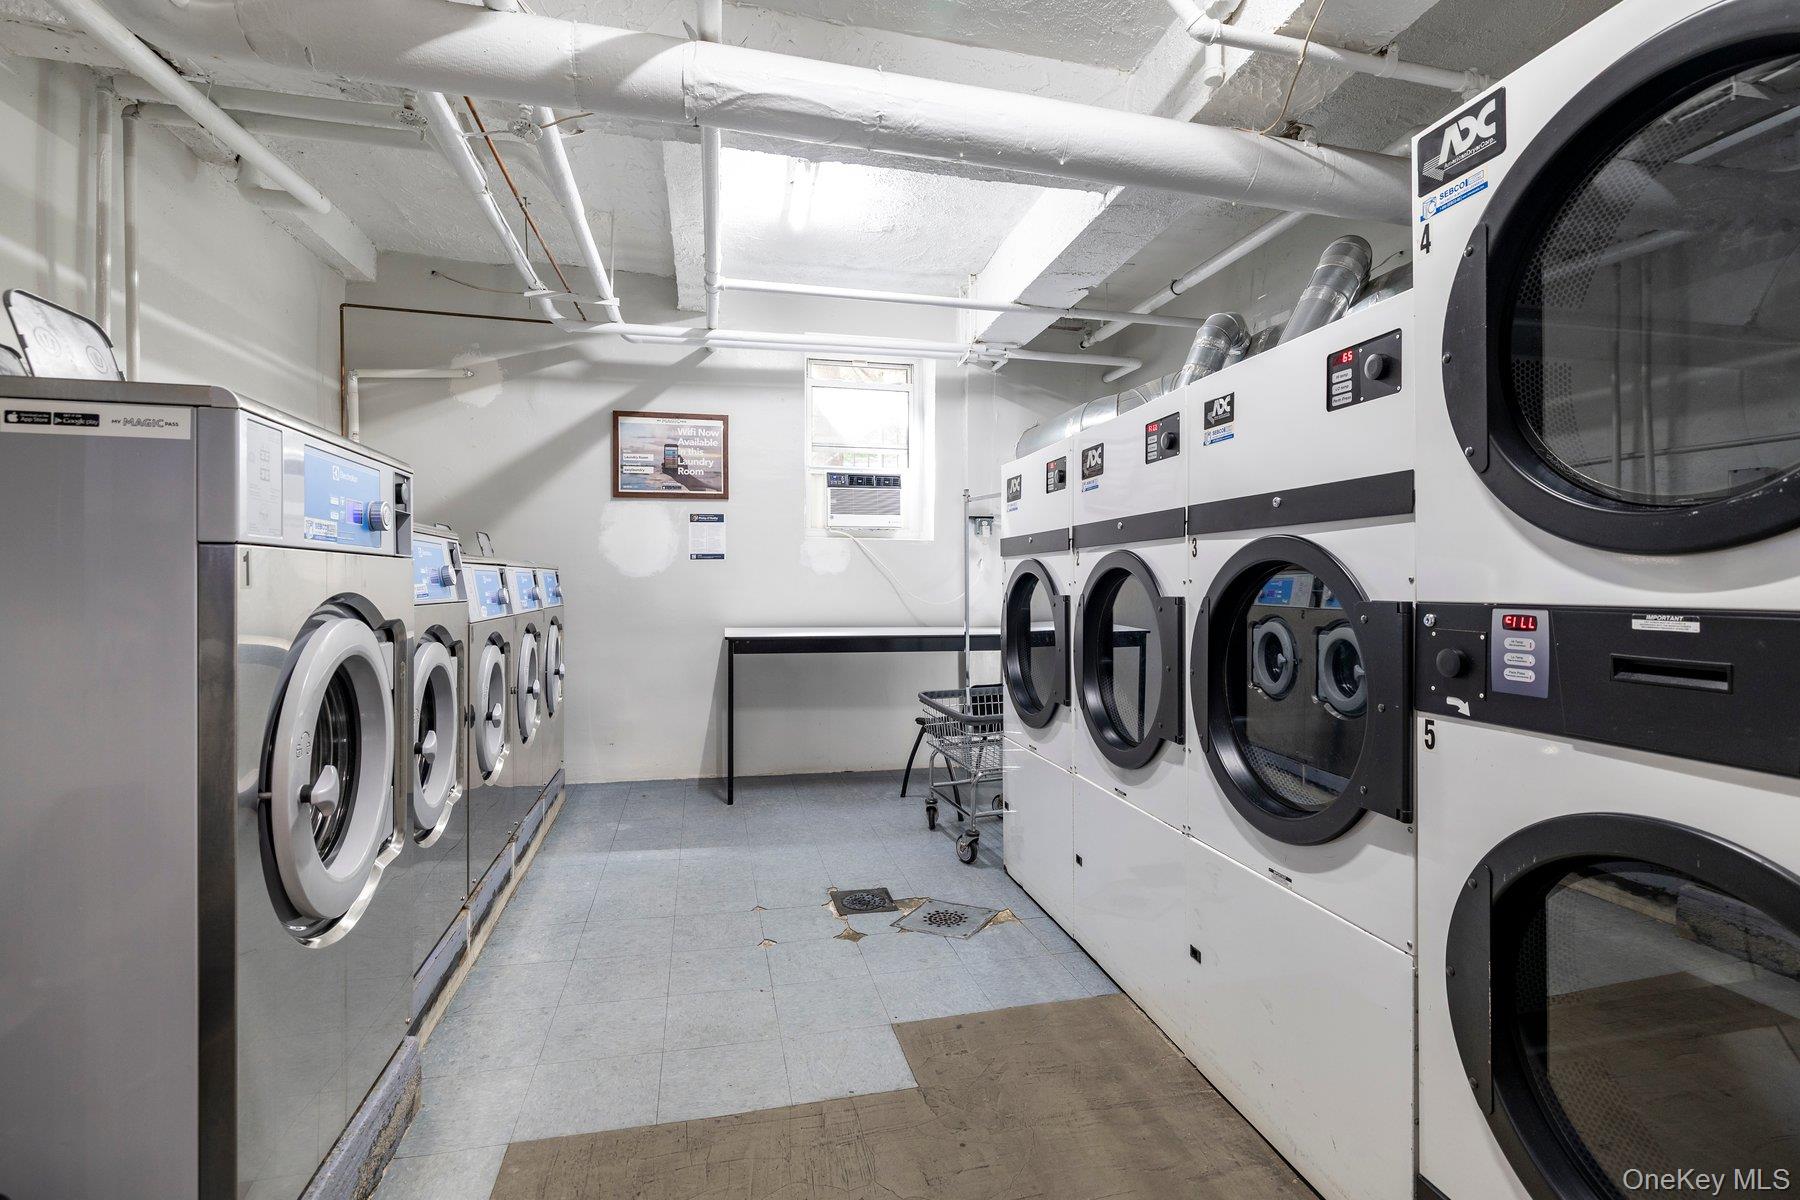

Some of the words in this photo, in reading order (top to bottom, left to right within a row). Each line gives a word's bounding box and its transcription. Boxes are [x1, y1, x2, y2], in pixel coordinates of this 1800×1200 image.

[1437, 98, 1496, 166] ADC
[1420, 222, 1431, 254] 4
[1342, 350, 1353, 363] 65
[1212, 395, 1231, 417] ADC
[63, 417, 85, 426] Google
[122, 417, 164, 428] MAGIC
[677, 427, 697, 437] Wifi
[698, 429, 720, 437] Now
[677, 438, 719, 447] Available
[687, 448, 704, 456] this
[677, 457, 714, 468] Laundry
[677, 468, 704, 476] Room
[1192, 537, 1198, 558] 3
[242, 550, 250, 586] 1
[1645, 614, 1684, 622] IMPORTANT
[1424, 718, 1436, 750] 5
